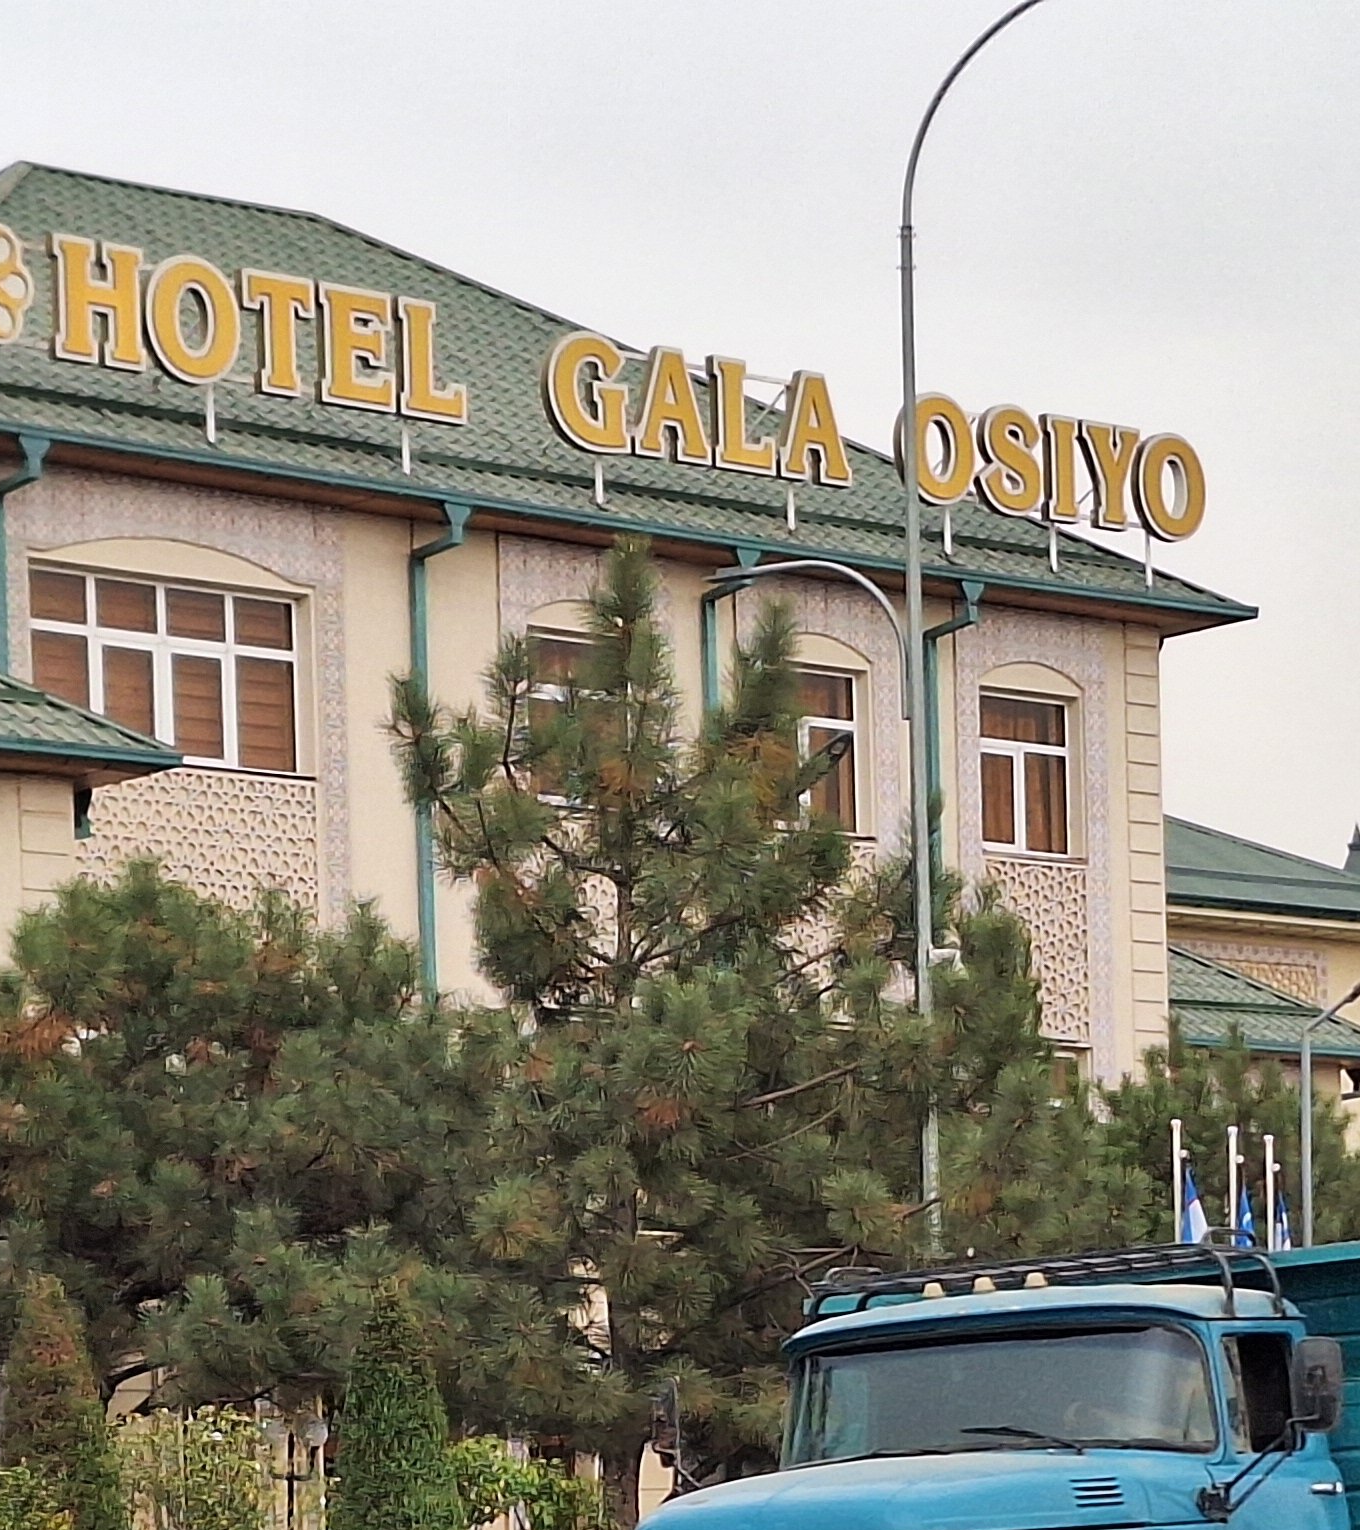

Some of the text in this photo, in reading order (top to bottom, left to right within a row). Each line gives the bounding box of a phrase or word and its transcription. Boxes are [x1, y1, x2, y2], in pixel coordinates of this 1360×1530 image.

[51, 232, 1207, 542] HOTEL GALA OSIYO
